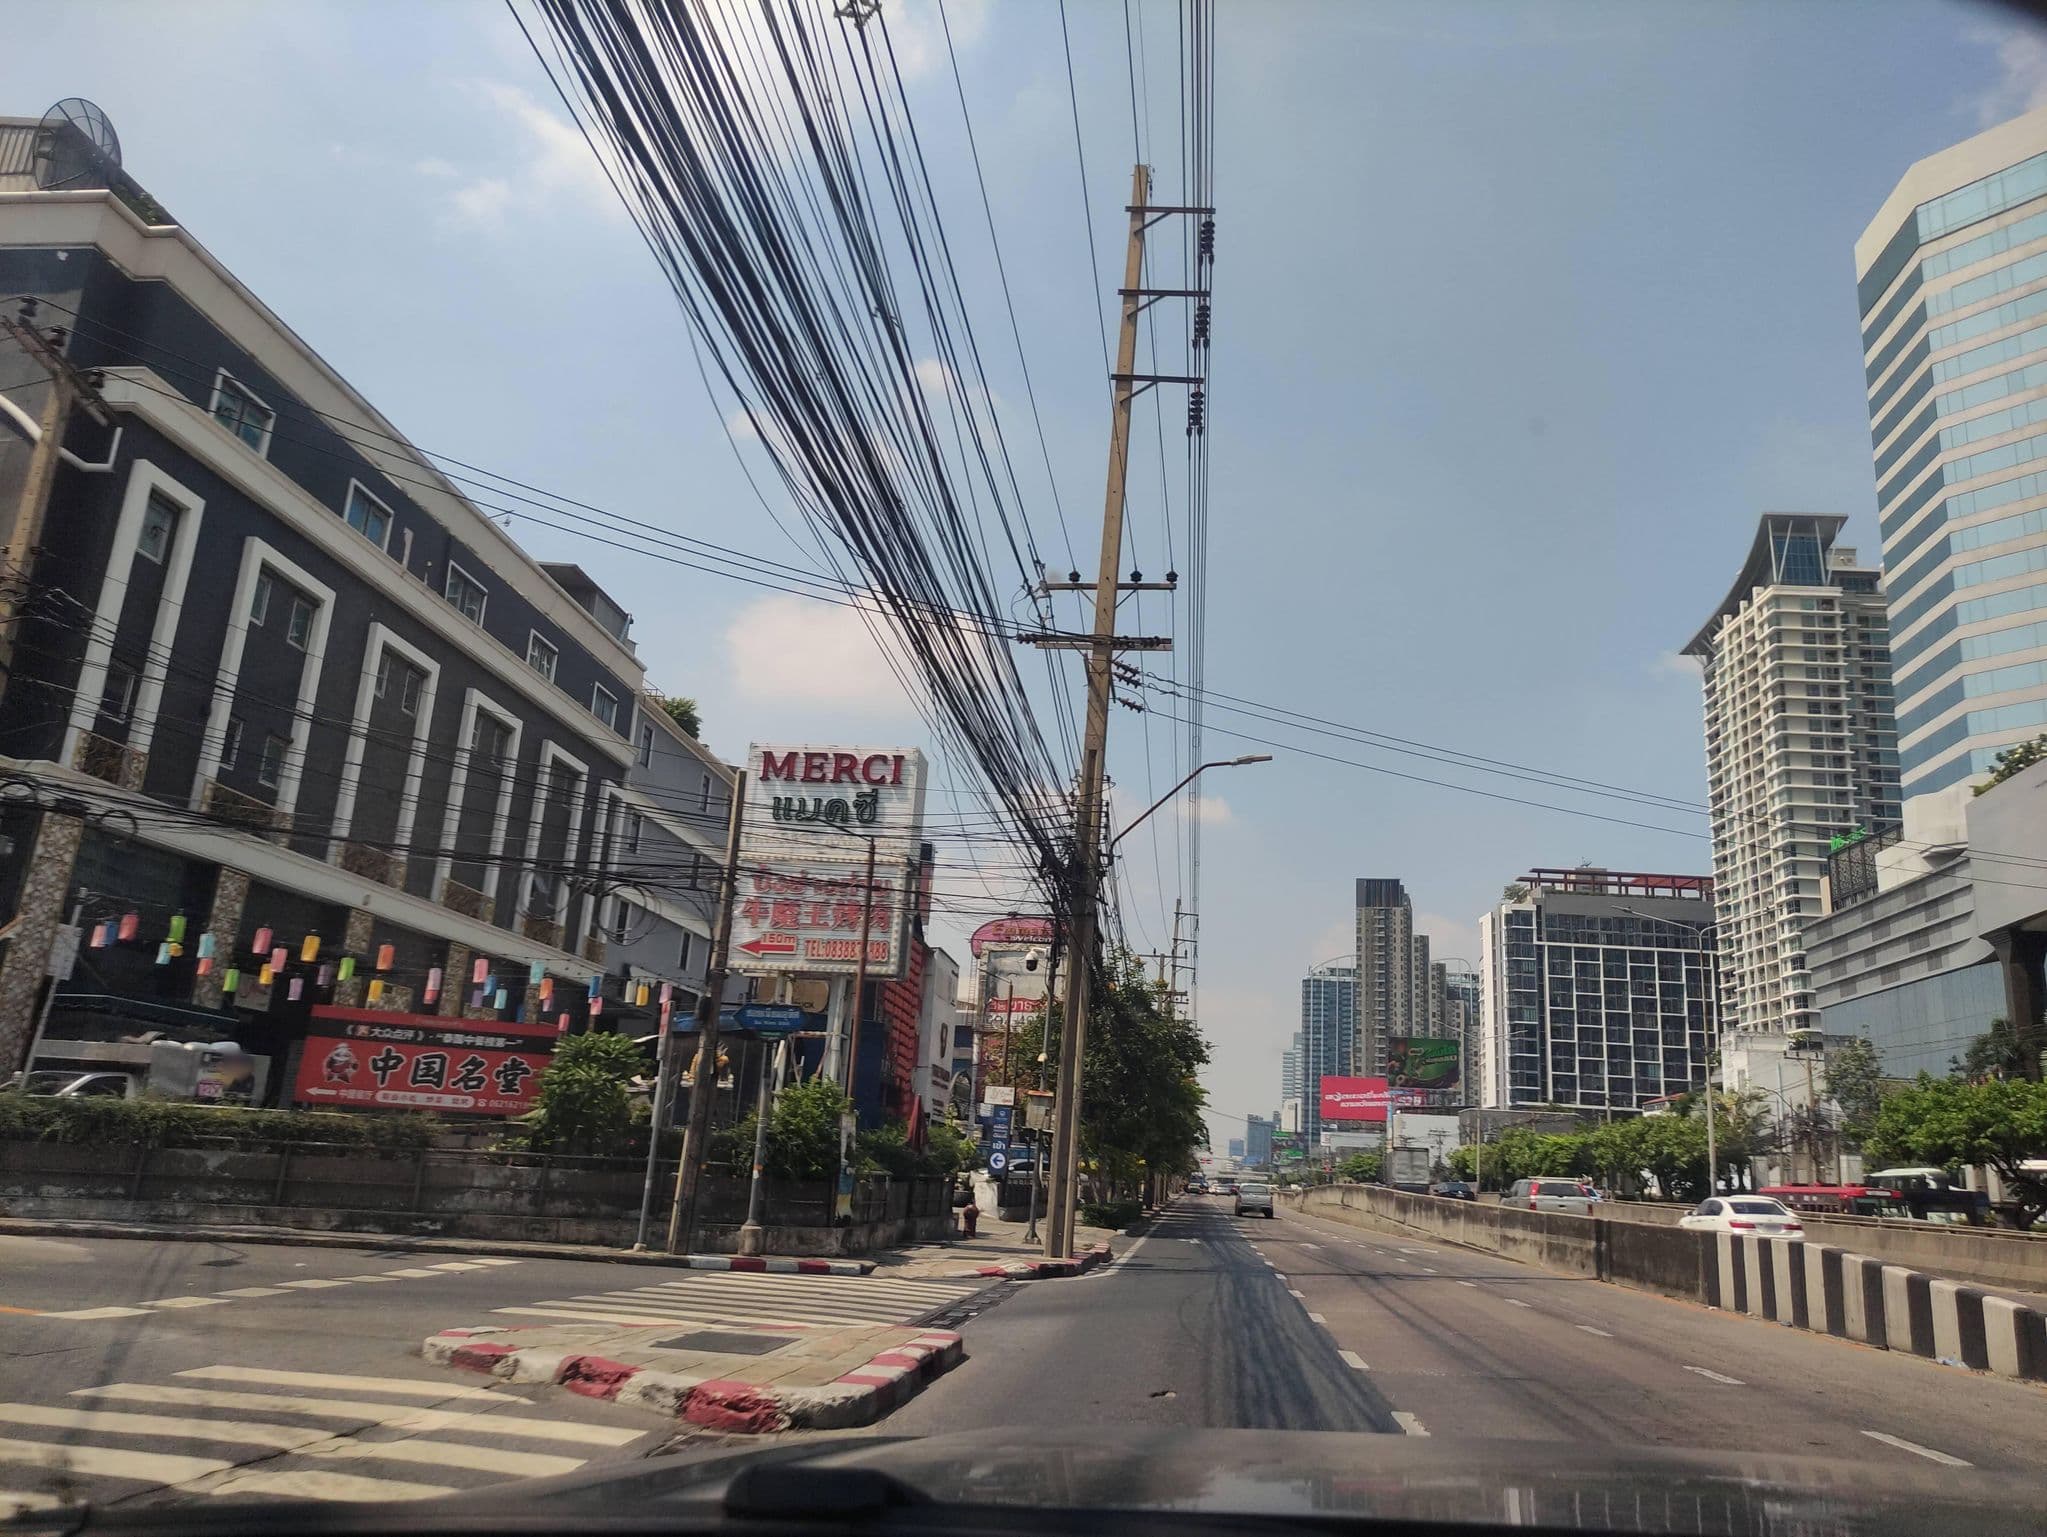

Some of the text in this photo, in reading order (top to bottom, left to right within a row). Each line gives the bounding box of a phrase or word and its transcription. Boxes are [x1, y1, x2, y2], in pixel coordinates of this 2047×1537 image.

[758, 750, 906, 785] MERCI
[762, 933, 795, 944] 150m
[369, 1046, 532, 1095] 中国名堂
